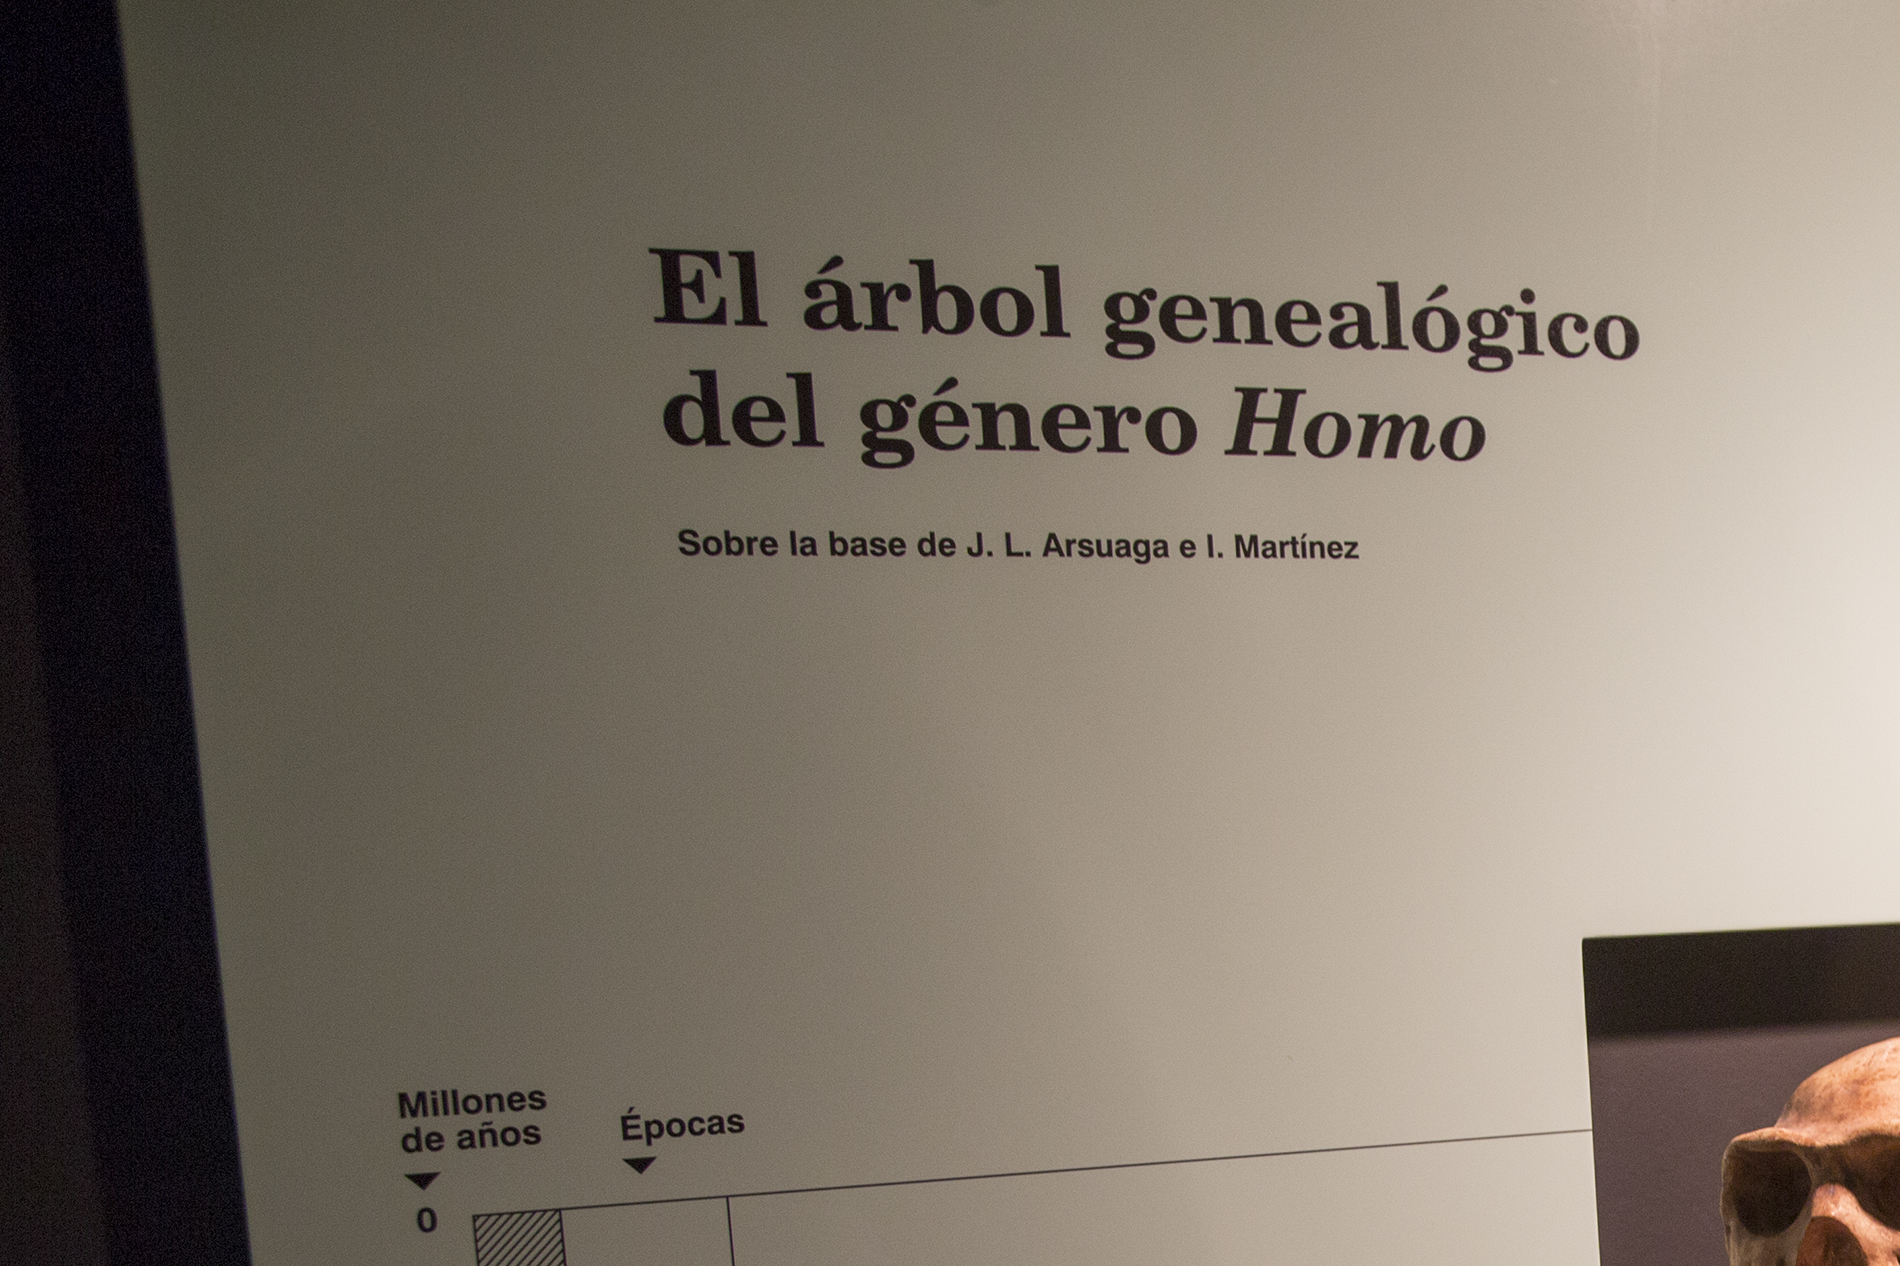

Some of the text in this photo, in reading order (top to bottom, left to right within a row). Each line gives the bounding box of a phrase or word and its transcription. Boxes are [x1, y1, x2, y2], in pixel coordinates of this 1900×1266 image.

[648, 247, 1640, 371] El árbol genealógico
[661, 370, 1486, 468] del género Homo
[678, 529, 1359, 565] Sobre la base de J. L. Arsuaga e I. Martínez
[398, 1087, 547, 1118] Millones
[401, 1121, 542, 1153] de años
[620, 1107, 745, 1144] Épocas
[417, 1208, 437, 1233] 0
